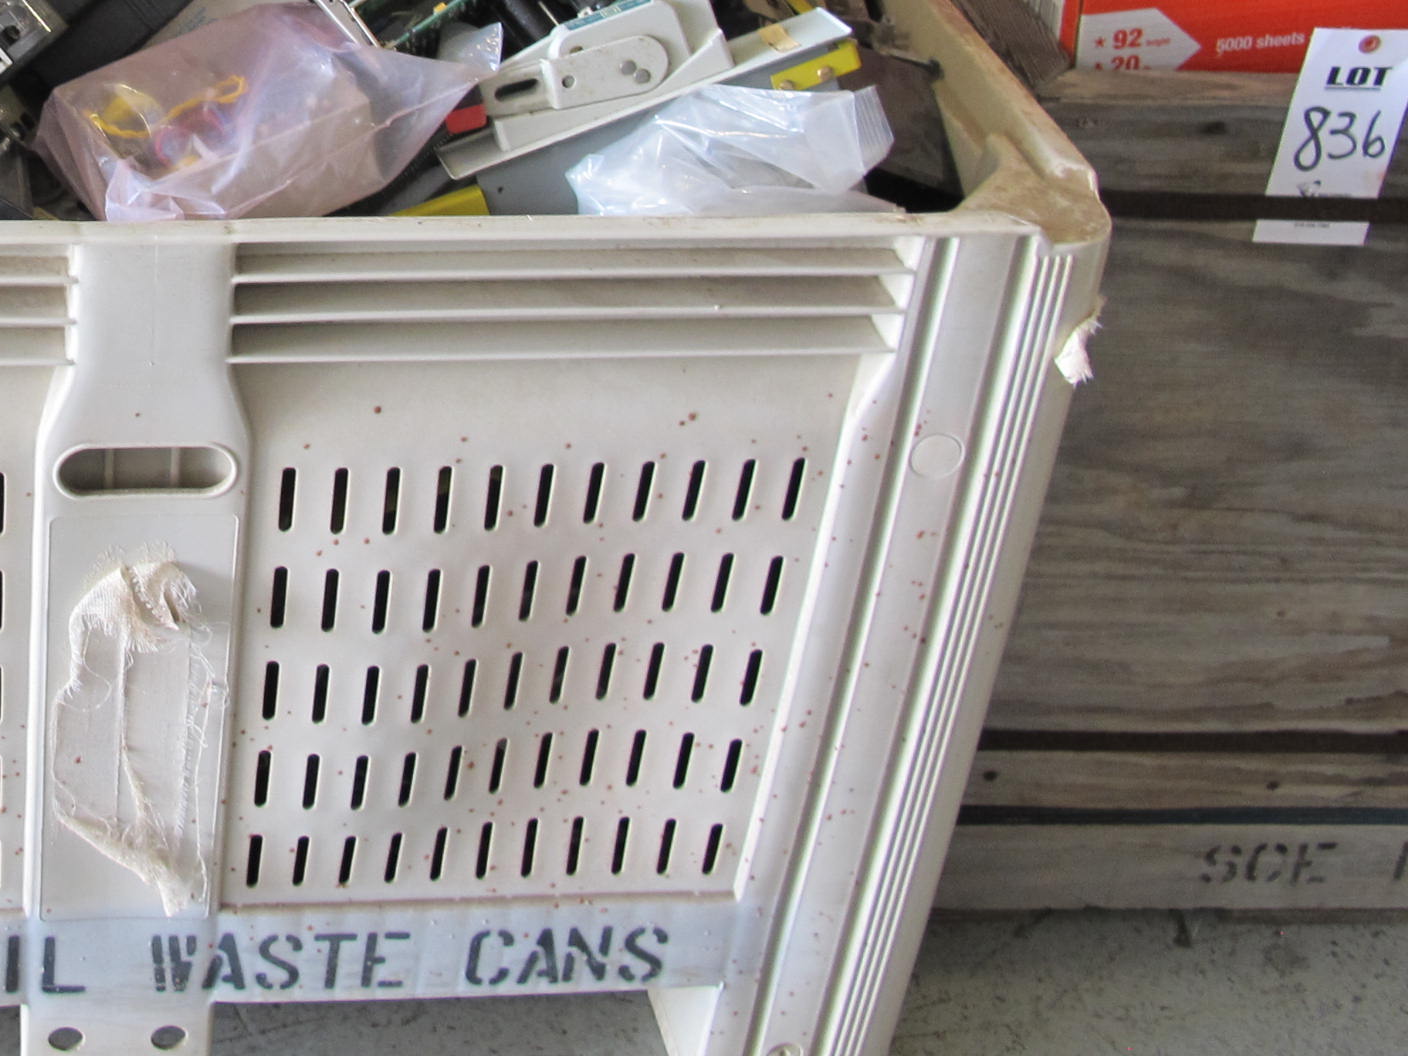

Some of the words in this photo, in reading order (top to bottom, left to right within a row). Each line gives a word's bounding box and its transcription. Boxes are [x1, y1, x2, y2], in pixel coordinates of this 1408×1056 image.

[1112, 28, 1144, 50] 92
[1216, 36, 1253, 53] 5000
[1256, 31, 1306, 48] sheets
[1325, 66, 1393, 87] LOT
[1294, 106, 1386, 172] 836
[1199, 843, 1340, 884] SCE
[149, 931, 412, 993] WASTE
[464, 925, 670, 986] CANS
